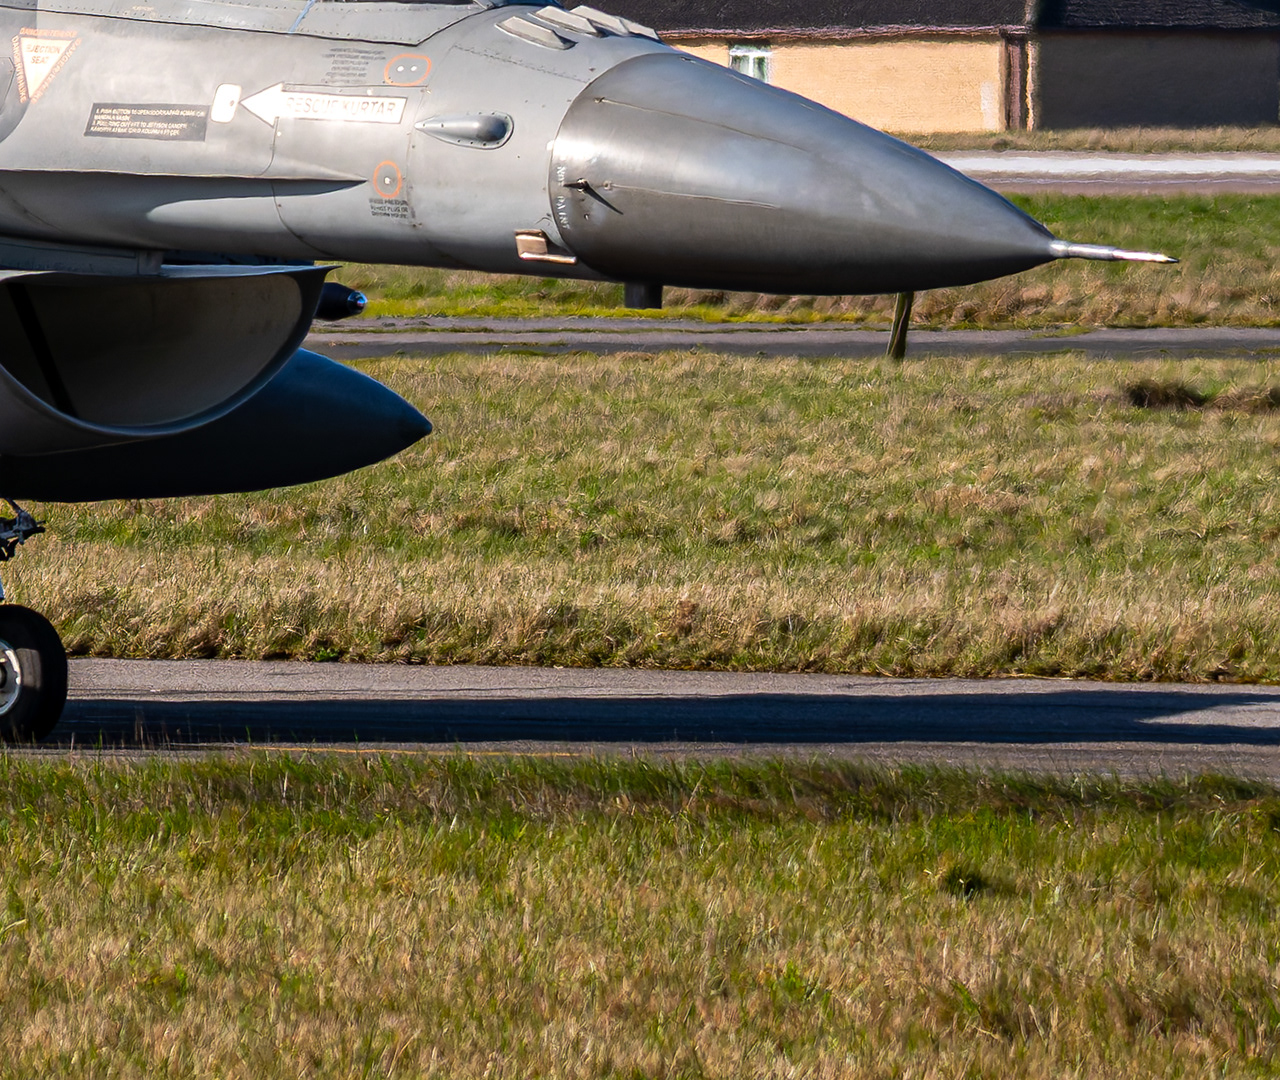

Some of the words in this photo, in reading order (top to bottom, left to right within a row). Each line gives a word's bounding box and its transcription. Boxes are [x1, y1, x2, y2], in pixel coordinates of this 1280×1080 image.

[25, 44, 61, 54] EJECTION
[31, 55, 50, 64] SEAT
[286, 97, 339, 114] RESCUE
[342, 100, 397, 117] KURTAR
